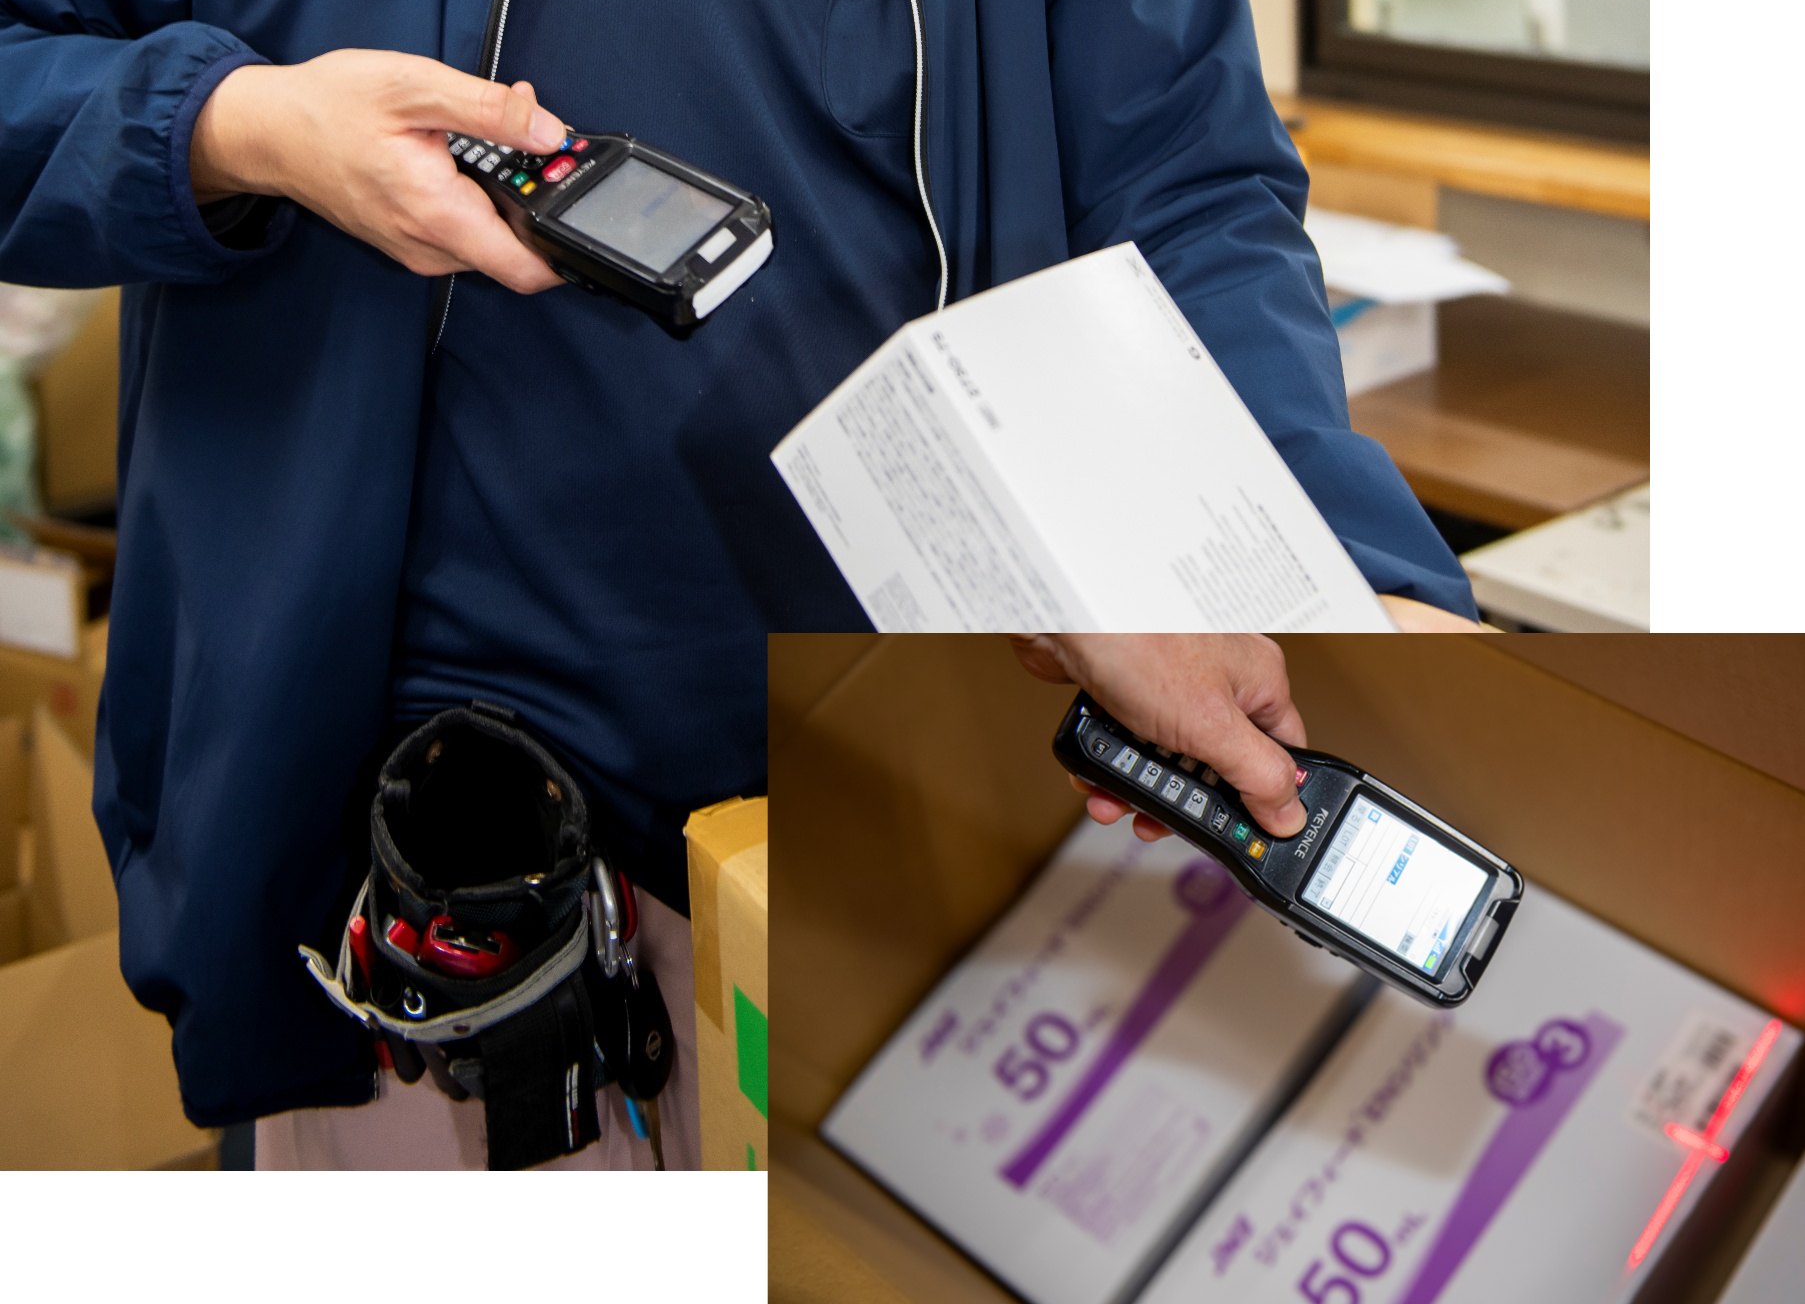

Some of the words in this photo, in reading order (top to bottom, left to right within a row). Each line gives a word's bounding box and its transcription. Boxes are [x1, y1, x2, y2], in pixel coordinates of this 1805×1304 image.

[1169, 779, 1181, 792] 6
[1191, 792, 1203, 805] 3
[1294, 807, 1329, 860] KEYENCE
[993, 1008, 1081, 1104] 50
[1296, 1220, 1392, 1304] 50
